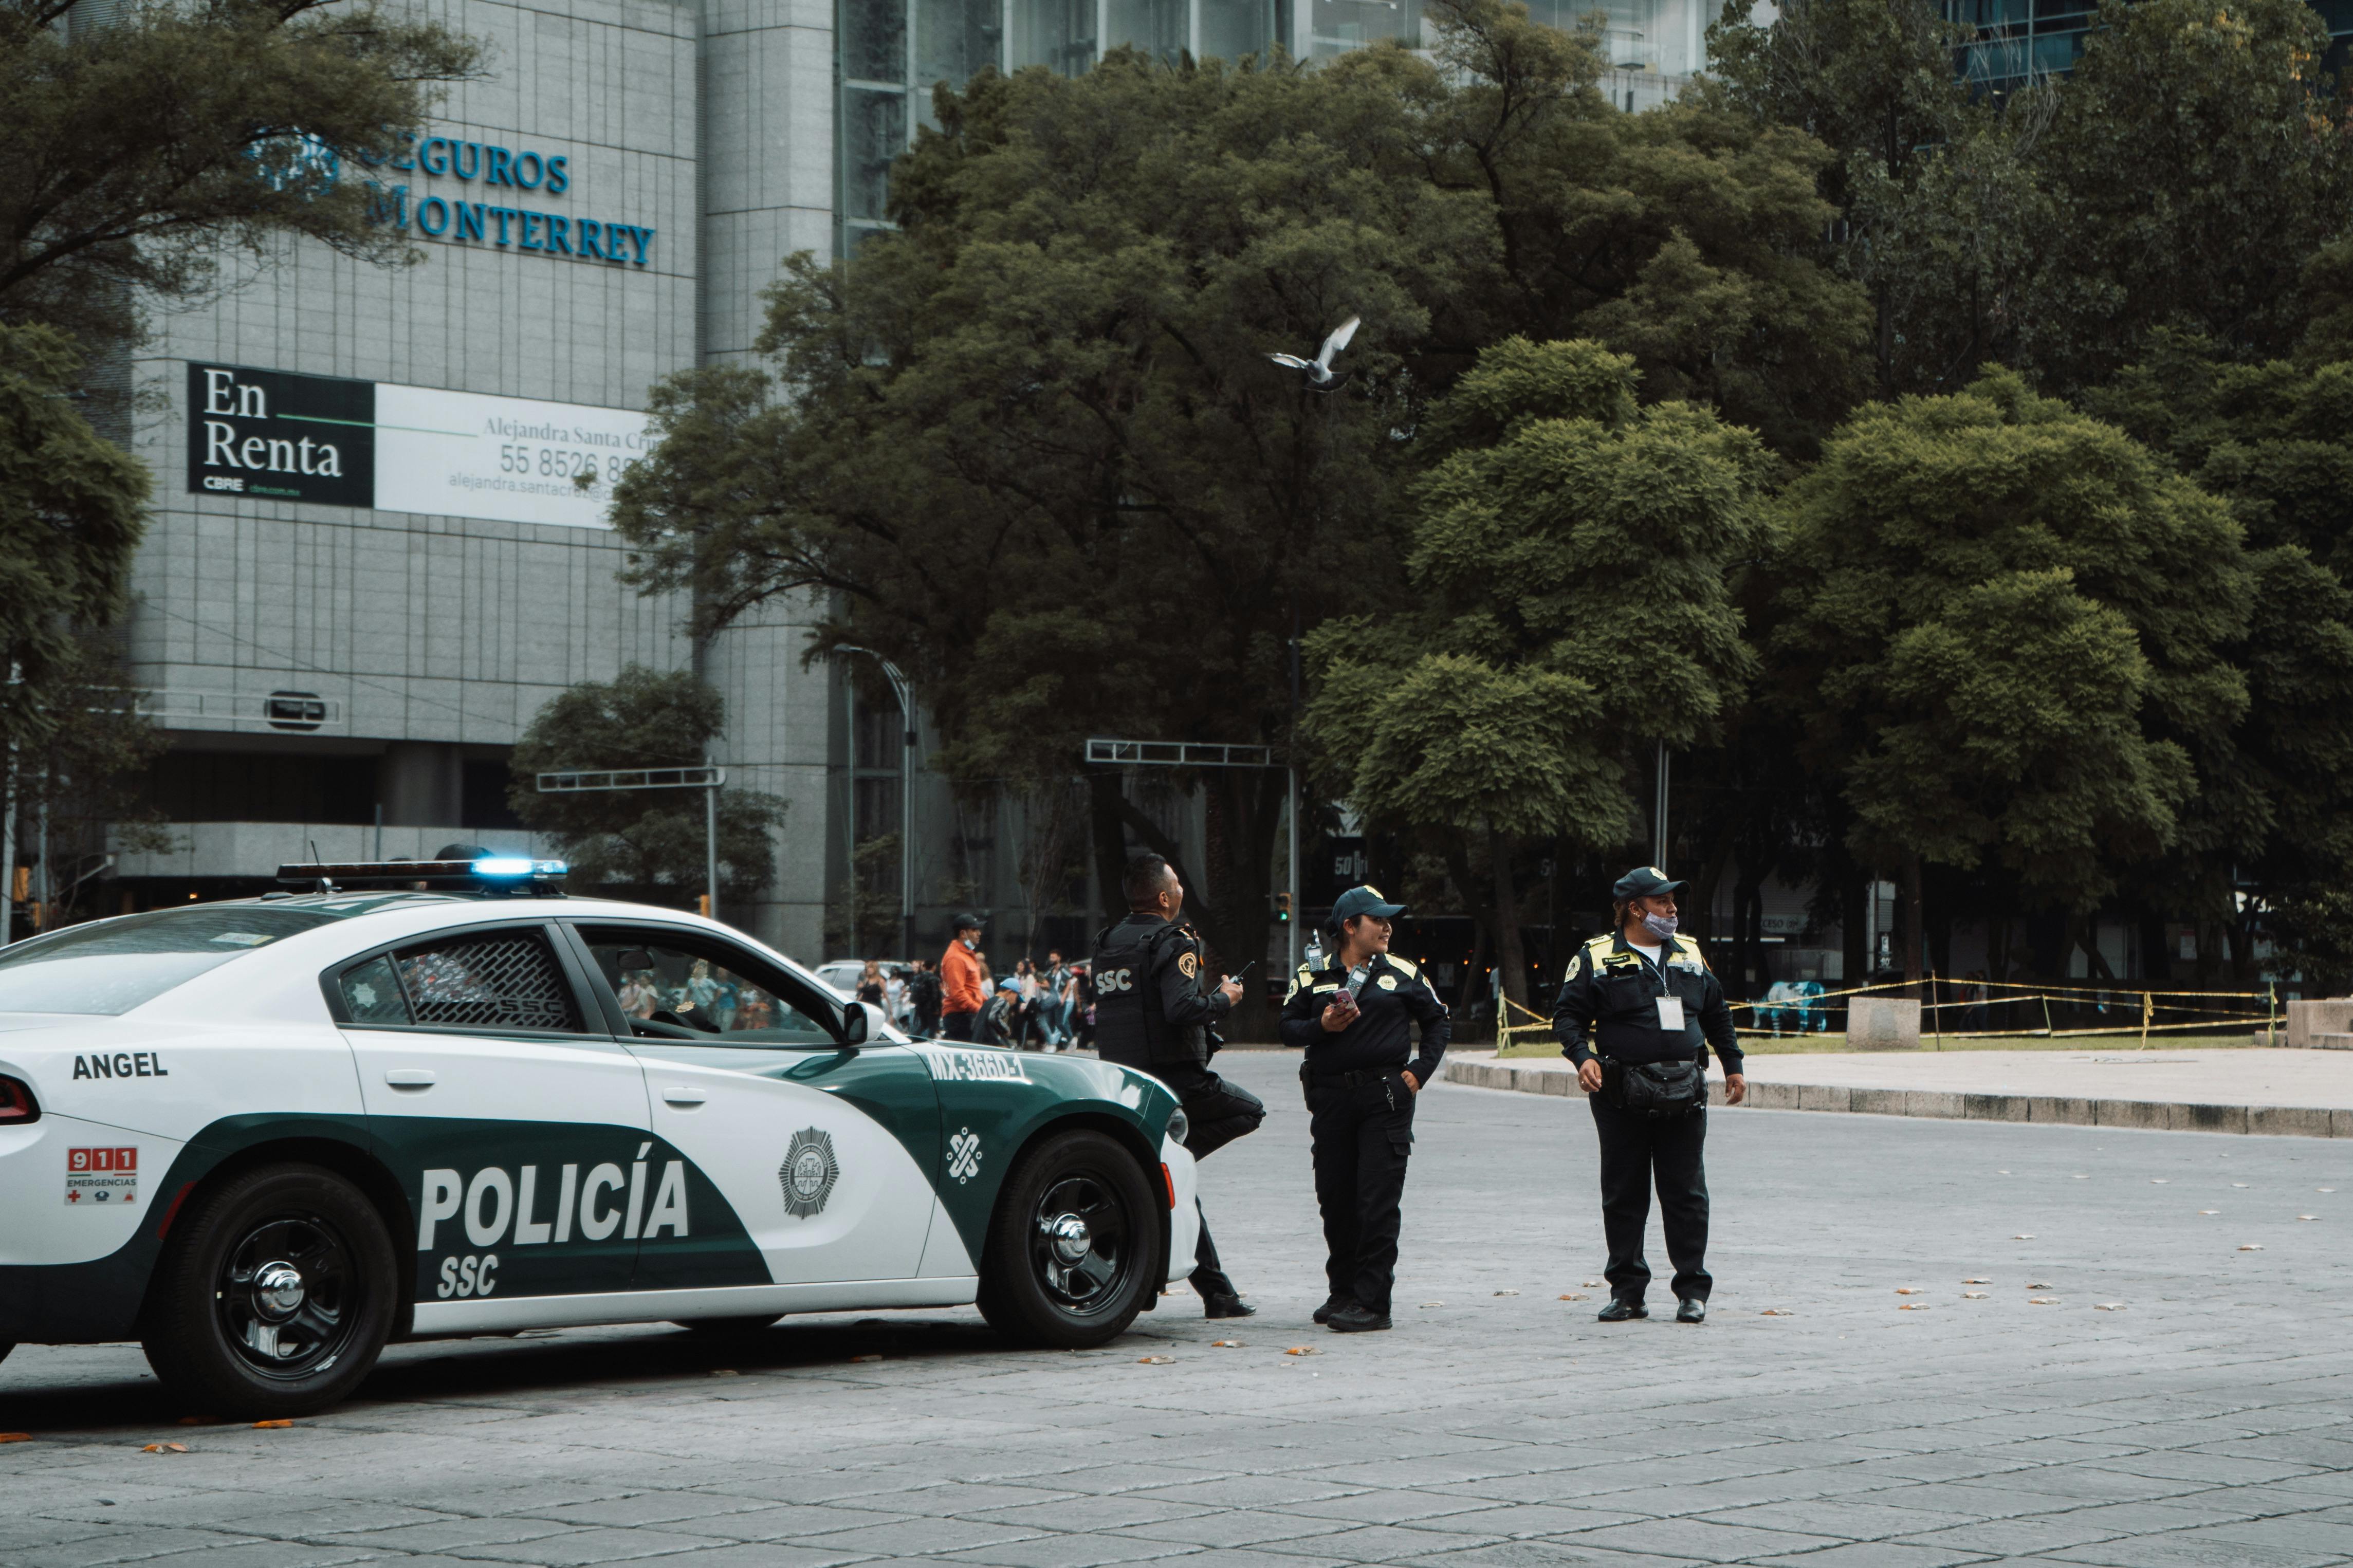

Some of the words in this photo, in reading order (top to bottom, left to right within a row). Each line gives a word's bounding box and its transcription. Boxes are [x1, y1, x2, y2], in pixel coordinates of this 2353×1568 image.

[203, 368, 268, 419] En
[203, 419, 343, 477] Renta
[485, 417, 568, 442] Alejandra
[574, 427, 620, 448] Santa
[626, 433, 660, 451] Cru
[500, 445, 529, 474] 55
[539, 449, 598, 478] 8526
[203, 476, 244, 492] CBRE
[1096, 968, 1132, 995] SSC
[500, 1000, 562, 1013] SSC
[73, 1052, 168, 1080] ANGEL
[926, 1053, 1026, 1081] MX-366D-1
[73, 1151, 131, 1169] 911
[67, 1178, 136, 1187] EMERGENCIAS
[417, 1141, 688, 1251] POLICÍA
[437, 1254, 499, 1298] SSC
